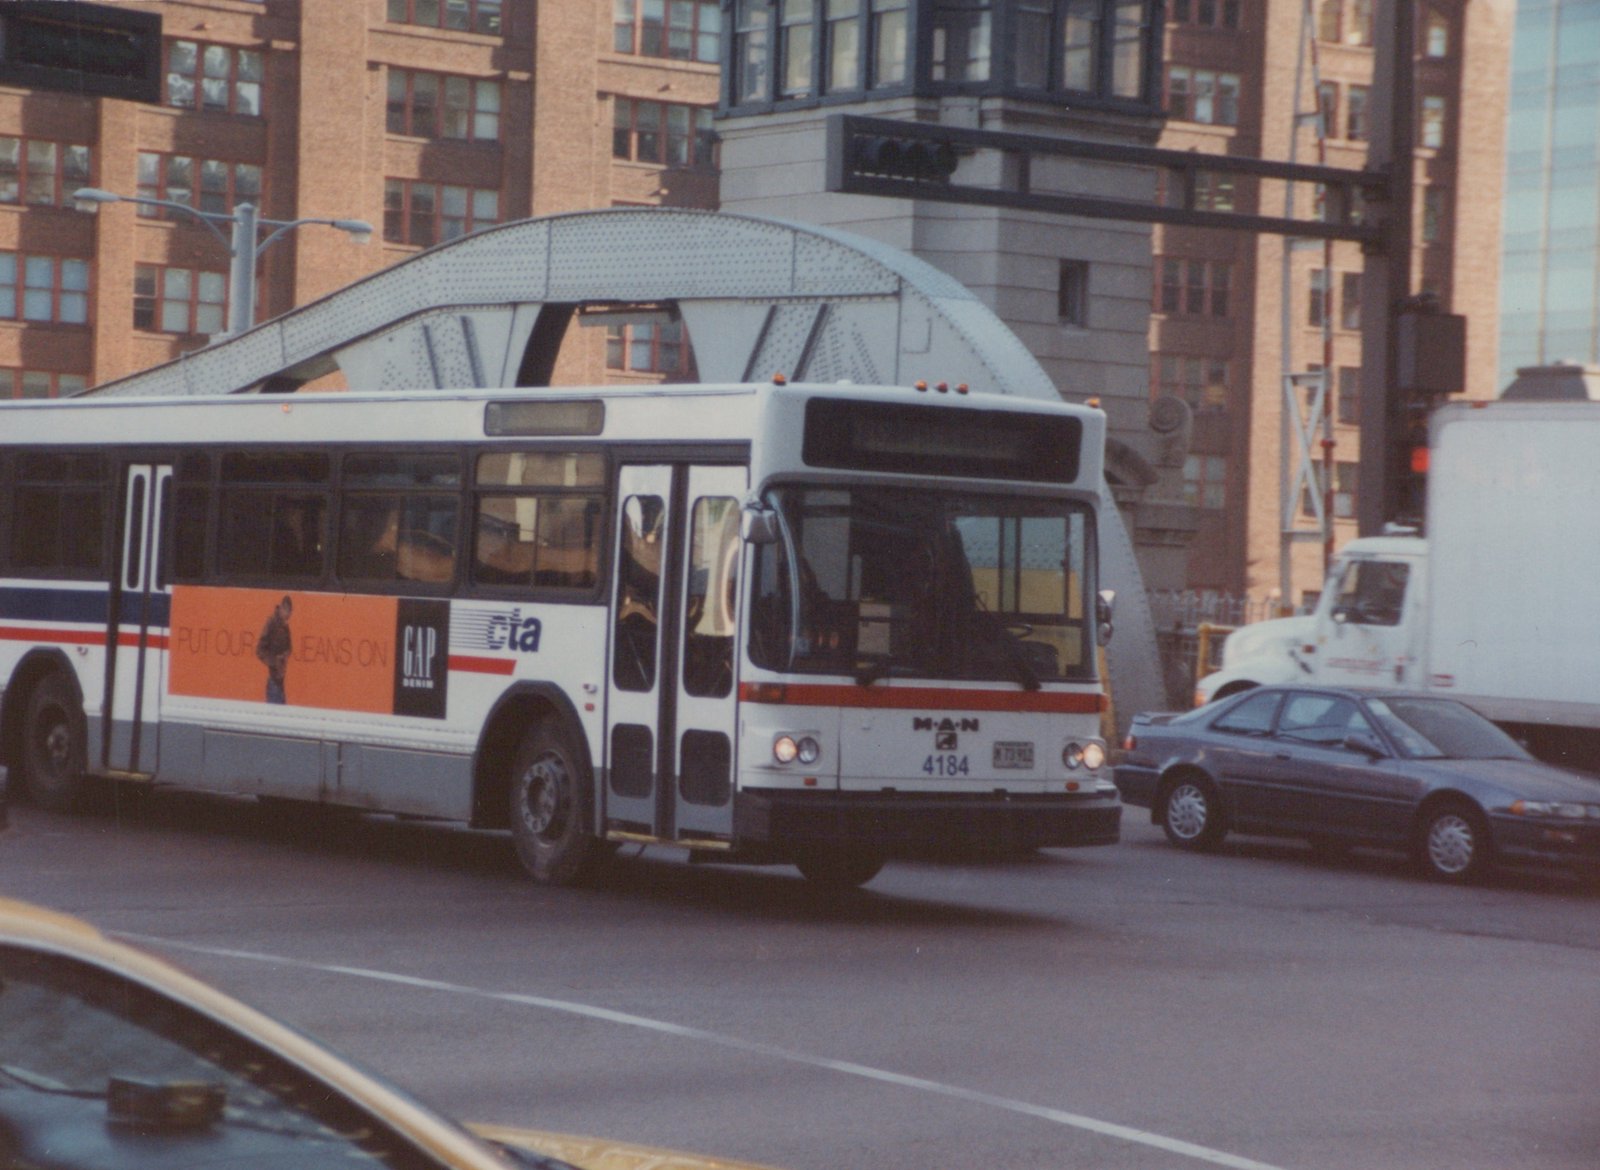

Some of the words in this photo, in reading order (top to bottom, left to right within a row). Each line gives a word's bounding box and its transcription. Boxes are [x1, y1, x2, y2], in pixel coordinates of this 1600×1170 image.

[178, 626, 211, 654] PUT
[215, 629, 255, 657] OUR
[294, 635, 353, 667] JEANS
[358, 638, 387, 668] ON
[403, 625, 436, 678] GAP
[487, 608, 543, 653] cta
[402, 678, 434, 689] DENIM
[922, 754, 969, 776] 4184
